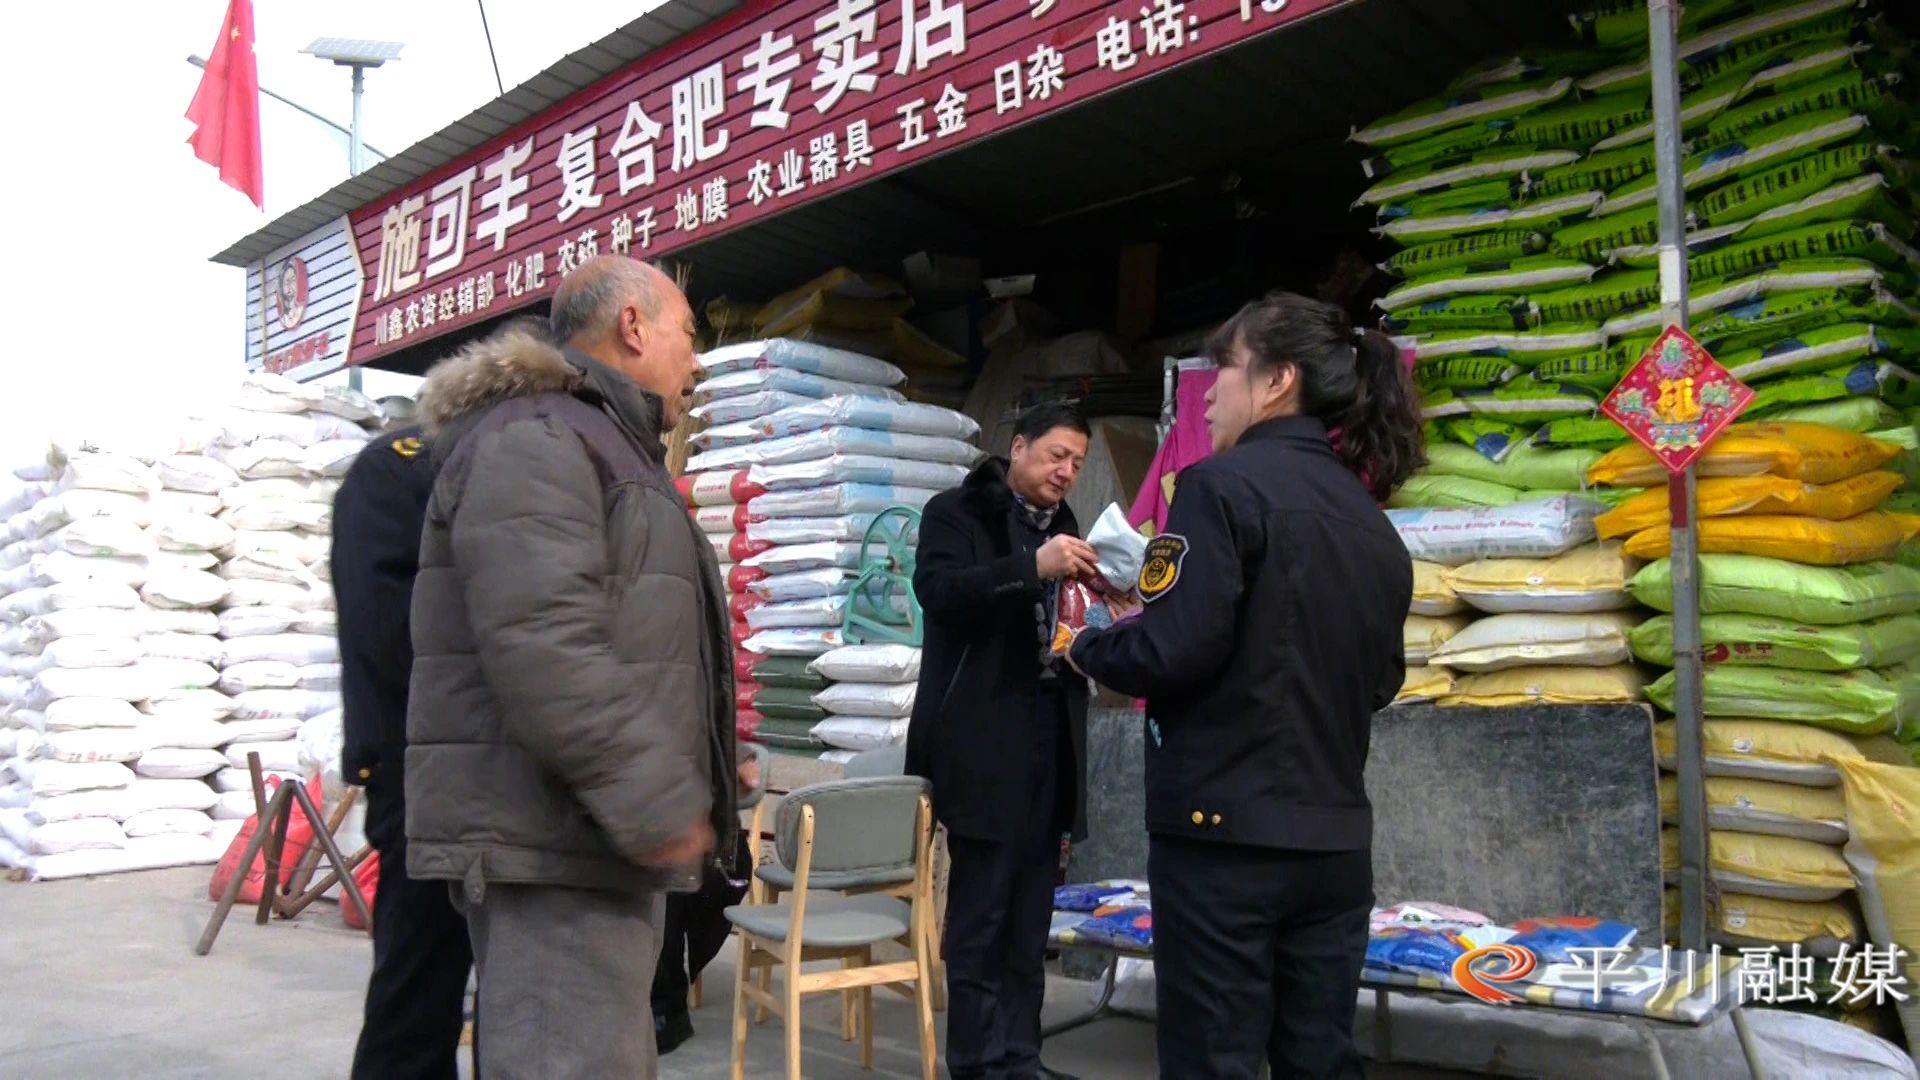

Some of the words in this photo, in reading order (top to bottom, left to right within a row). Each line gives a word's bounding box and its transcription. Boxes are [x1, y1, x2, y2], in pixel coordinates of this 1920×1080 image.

[373, 135, 534, 302] 施可丰
[556, 0, 968, 224] 复合肥专卖店
[374, 271, 495, 346] 川鑫农资经销部
[505, 252, 545, 298] 化肥
[557, 228, 599, 279] 农药
[611, 206, 657, 255] 种子
[674, 176, 729, 232] 地膜
[747, 118, 874, 206] 农业器具
[896, 83, 968, 152] 五金
[994, 43, 1065, 115] 日杂
[1096, 0, 1199, 72] 电话:
